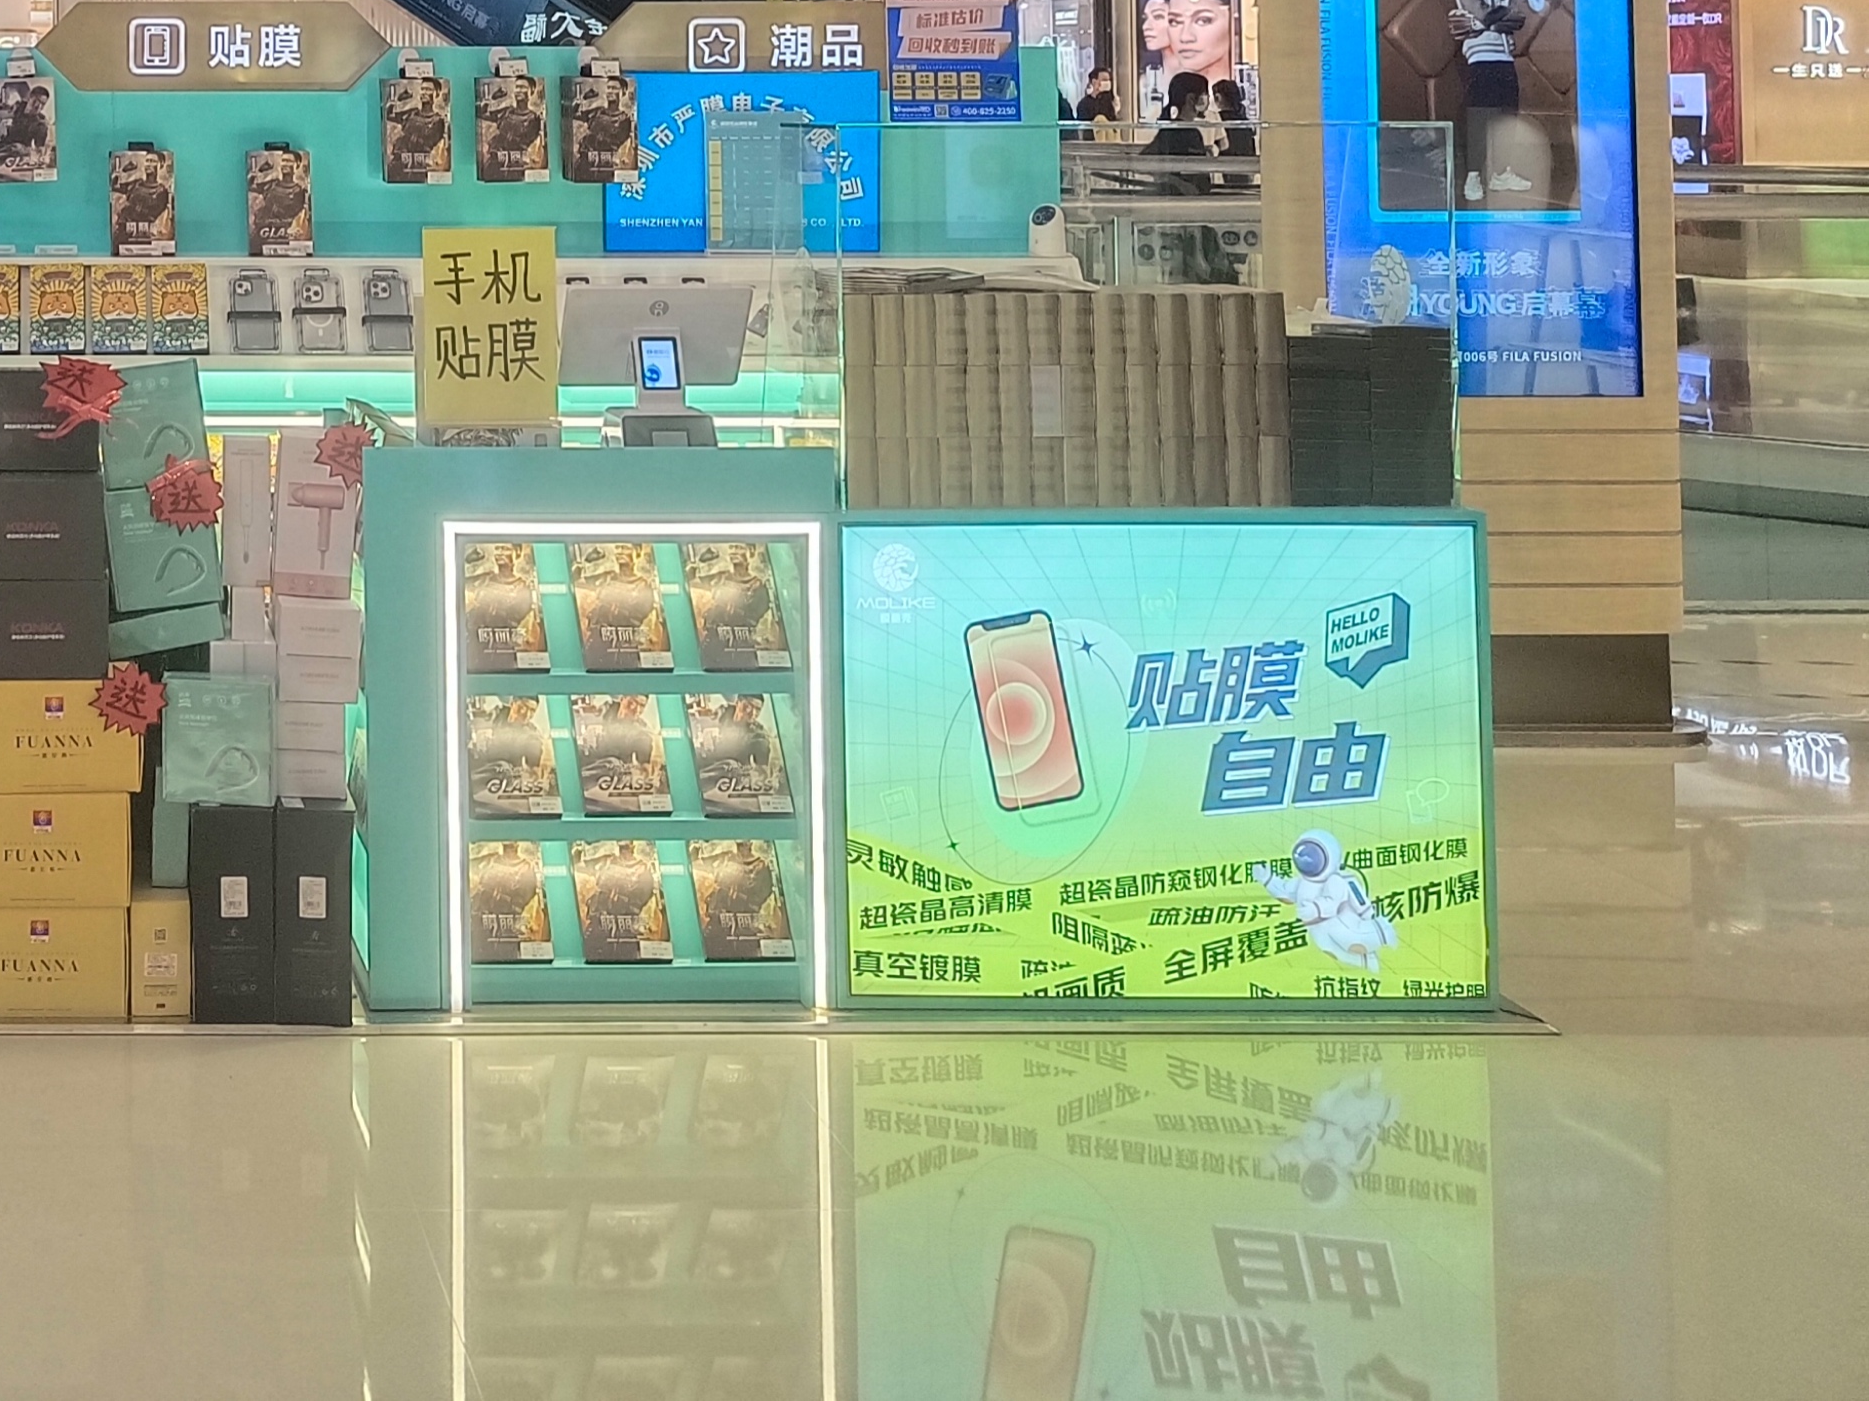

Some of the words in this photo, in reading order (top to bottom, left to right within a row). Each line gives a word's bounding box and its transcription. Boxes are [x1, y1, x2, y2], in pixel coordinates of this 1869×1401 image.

[1801, 5, 1850, 55] DR
[208, 24, 302, 68] 贴膜
[770, 24, 863, 68] 潮品
[620, 218, 679, 228] SHENZHEN
[682, 218, 704, 227] YAN
[434, 249, 542, 306] 手机
[435, 318, 545, 382] 贴膜
[1503, 352, 1530, 362] FILA
[1534, 351, 1581, 362] FUSION
[167, 483, 211, 514] 送
[856, 596, 936, 609] MOLIKE
[1330, 608, 1380, 634] HELLO
[1331, 623, 1391, 655] MOLIKE
[1126, 639, 1306, 732] 贴膜
[106, 685, 149, 720] 送
[15, 735, 93, 748] FUANNA
[597, 774, 656, 794] GLASS
[1200, 721, 1390, 817] 自由
[486, 776, 544, 796] GLASS
[716, 775, 775, 795] GLASS
[3, 849, 81, 863] FUANNA
[859, 888, 1033, 931] 超瓷晶高清膜
[1148, 904, 1282, 926] 疏油防汗
[1, 959, 79, 972] FUANNA
[853, 950, 982, 983] 真空镀膜
[1164, 918, 1309, 984] 全屏覆盖
[1314, 975, 1381, 998] 抗指纹
